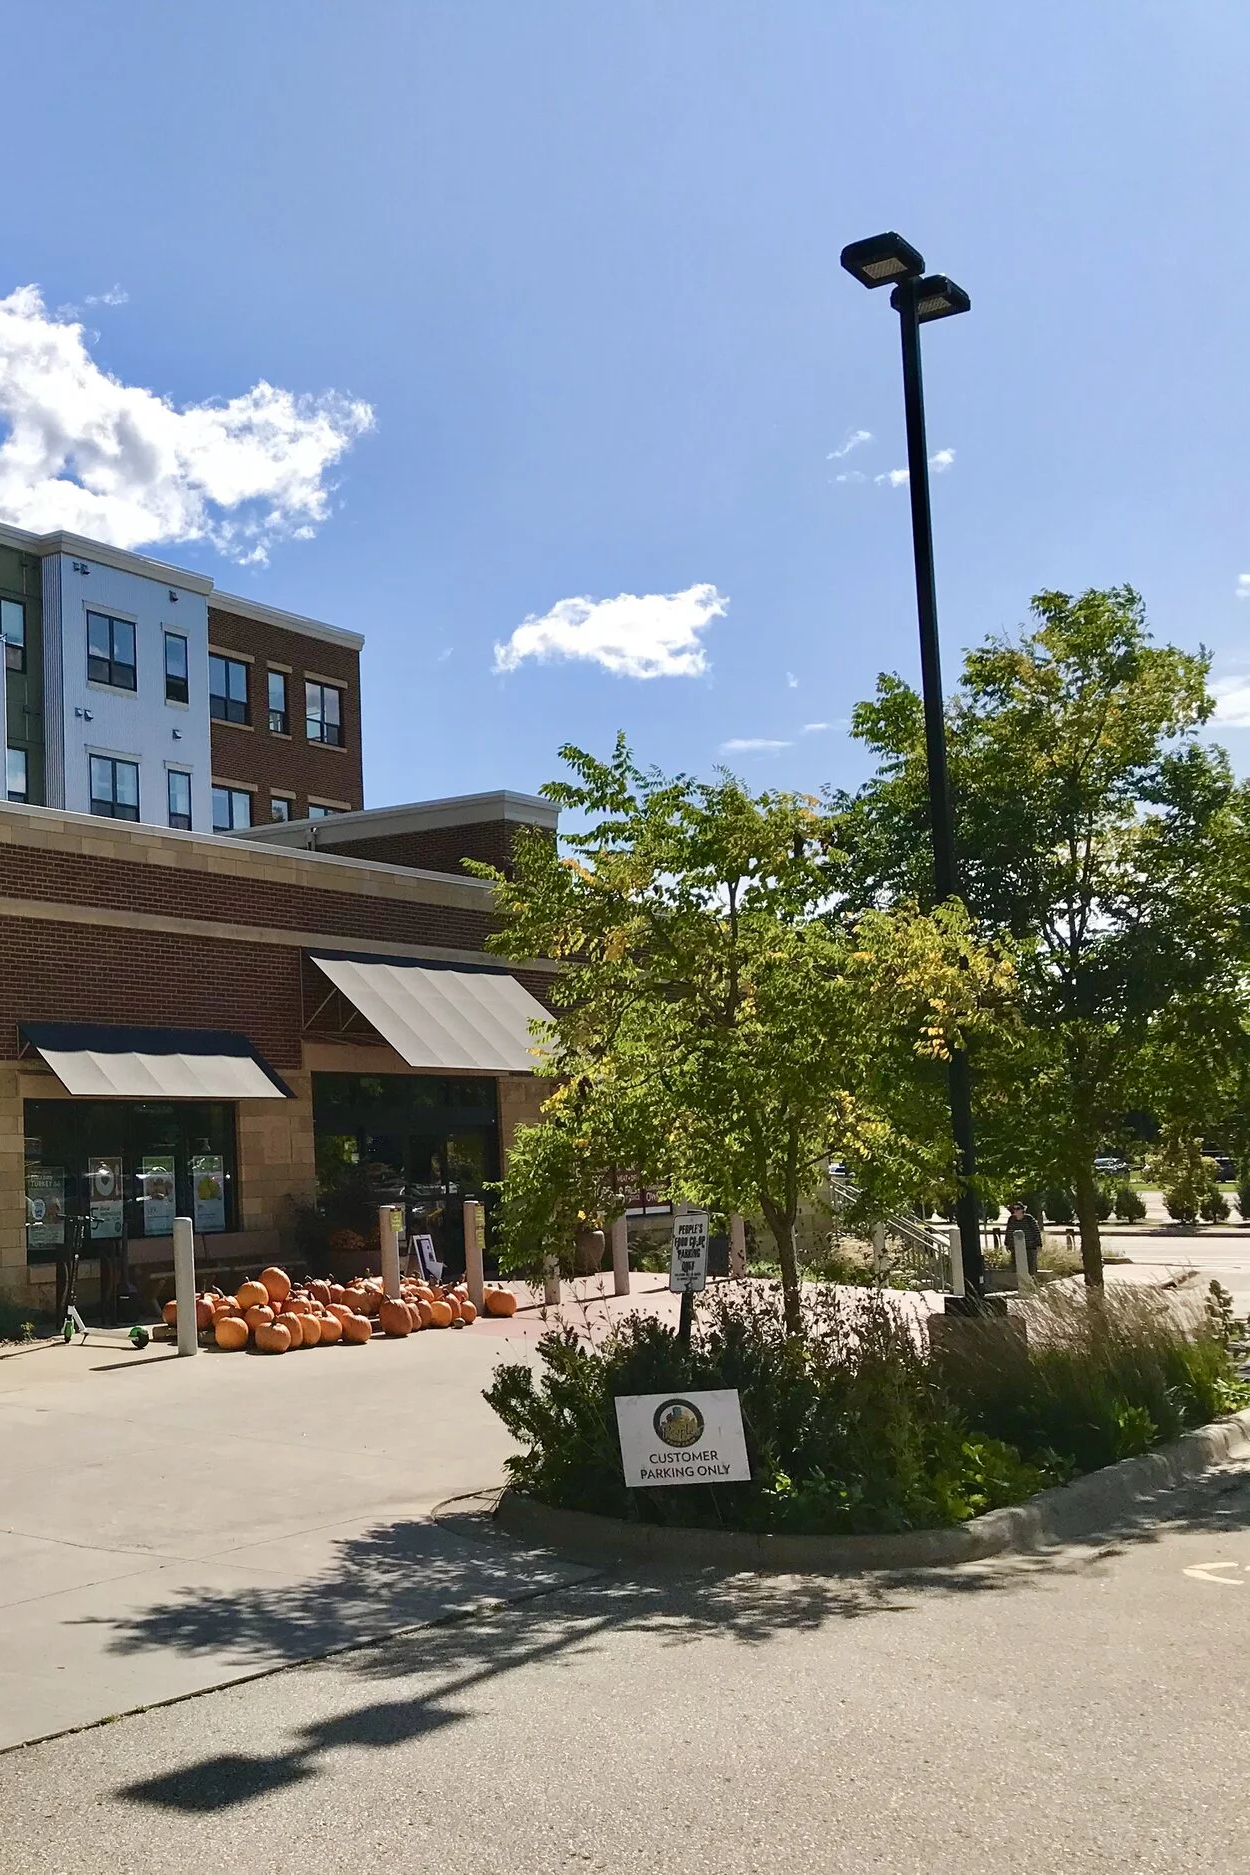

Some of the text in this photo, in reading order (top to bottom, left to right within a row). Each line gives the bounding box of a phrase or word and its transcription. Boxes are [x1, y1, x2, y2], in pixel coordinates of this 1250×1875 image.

[678, 1223, 704, 1235] PEOPLE'S
[677, 1248, 701, 1259] PARKING
[649, 1450, 719, 1464] CUSTOMER
[640, 1464, 731, 1480] PARKING ONLY
